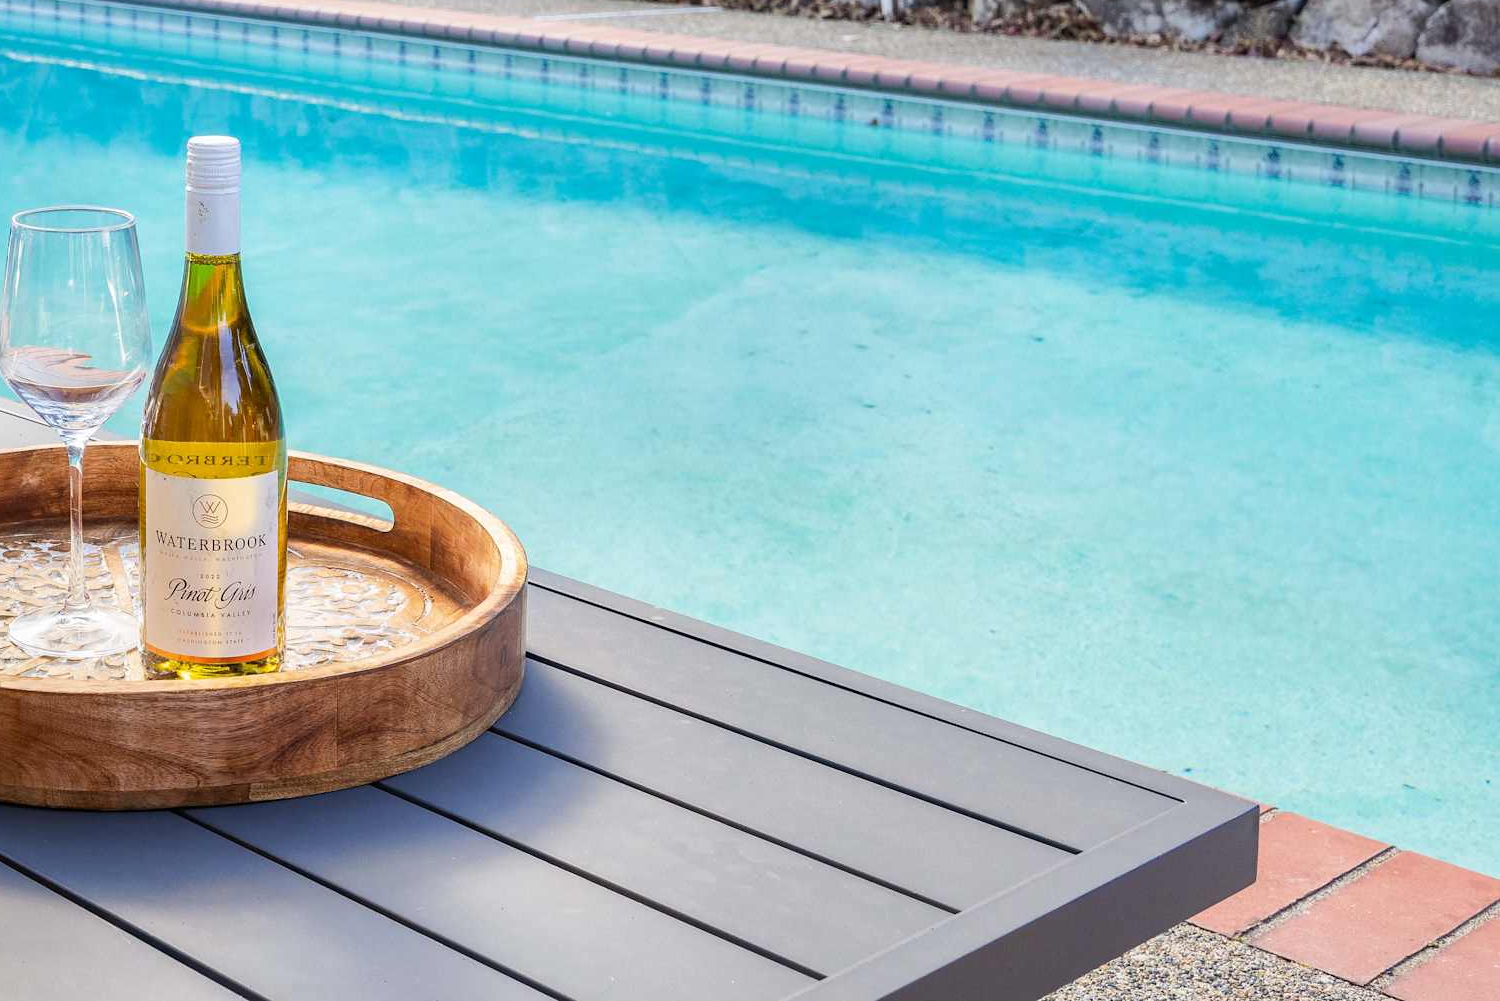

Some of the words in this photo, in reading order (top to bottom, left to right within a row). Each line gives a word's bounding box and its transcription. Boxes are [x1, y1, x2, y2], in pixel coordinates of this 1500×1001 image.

[156, 529, 267, 551] WATERBROOK
[164, 577, 221, 602] Pinot
[214, 581, 256, 609] Gris
[171, 608, 215, 618] COLUMBIA
[220, 609, 251, 618] VALLEY
